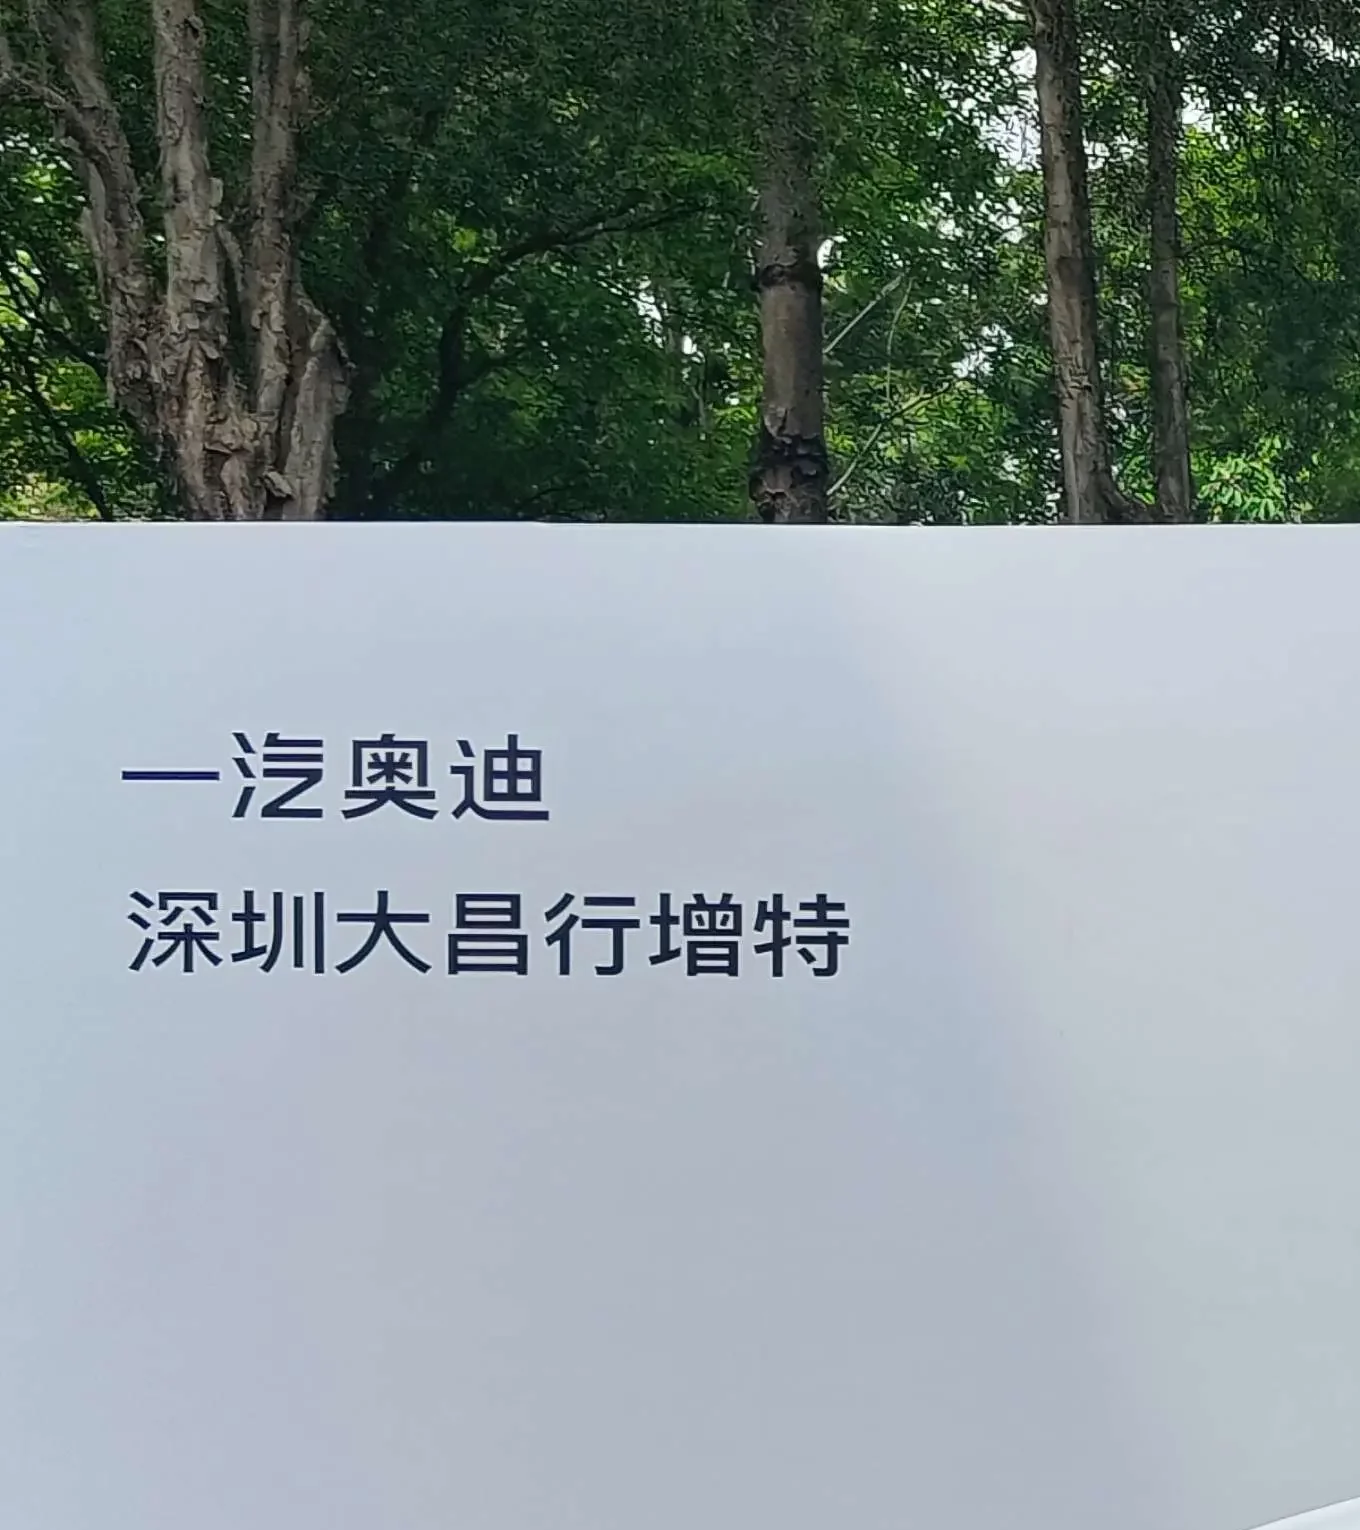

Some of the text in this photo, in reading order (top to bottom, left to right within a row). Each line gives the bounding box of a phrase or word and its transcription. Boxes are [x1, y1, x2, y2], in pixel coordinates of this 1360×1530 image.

[121, 731, 550, 822] 一汽奥迪
[126, 889, 851, 978] 深圳大昌行增特
